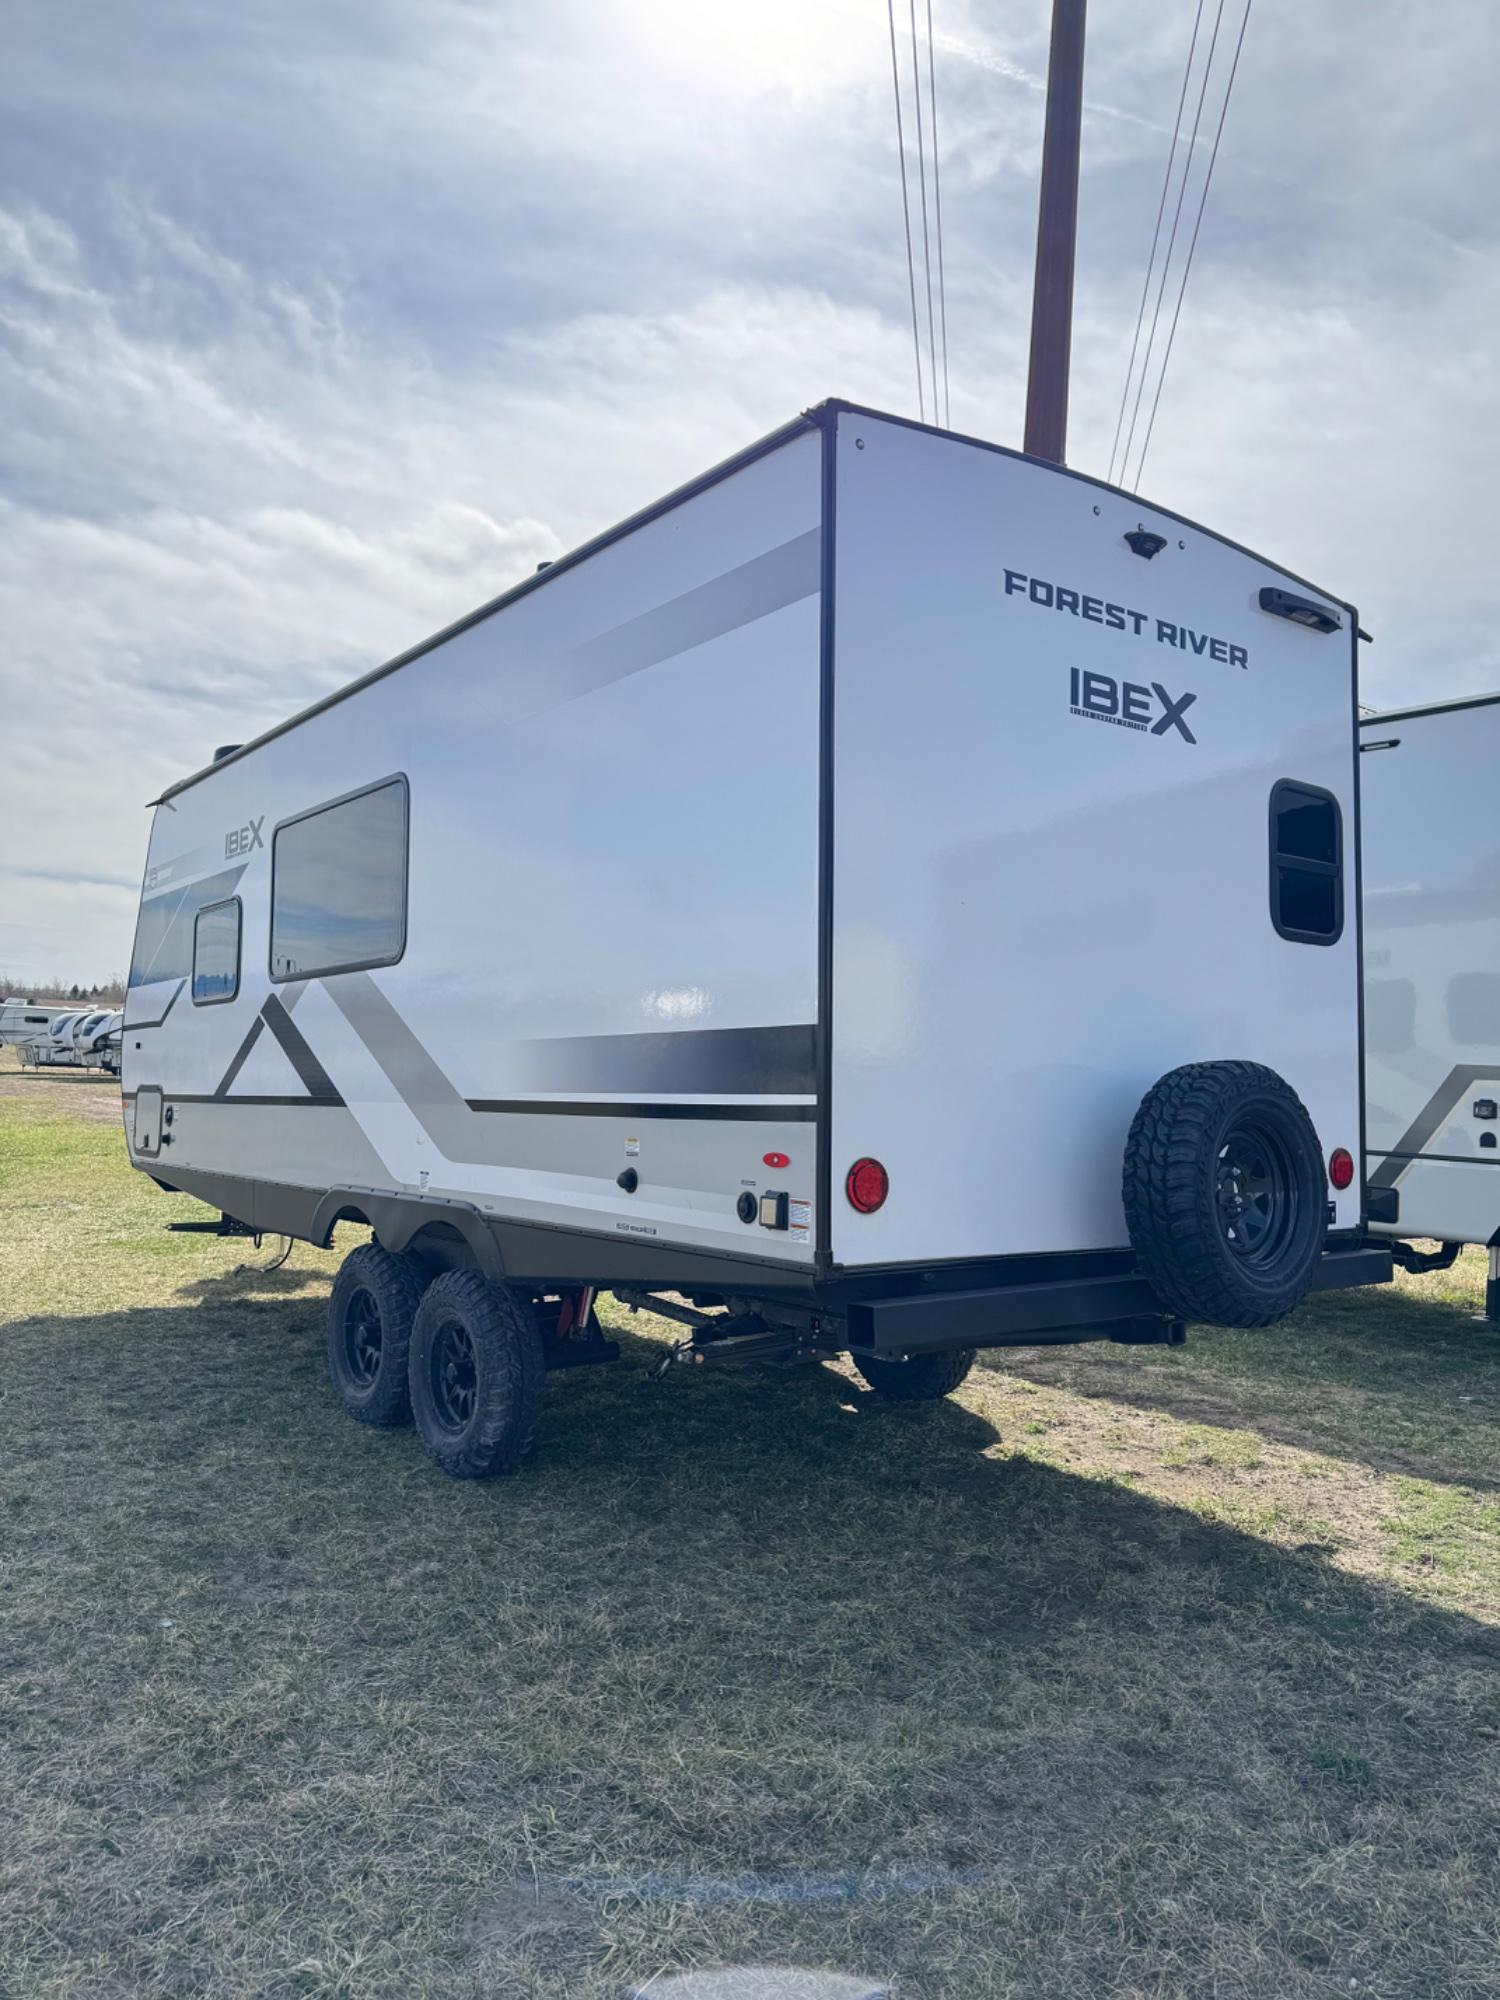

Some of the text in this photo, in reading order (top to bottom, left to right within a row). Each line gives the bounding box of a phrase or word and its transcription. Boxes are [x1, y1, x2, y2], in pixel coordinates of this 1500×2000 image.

[1002, 568, 1249, 670] FOREST RIVER
[1070, 666, 1198, 745] IBEX
[224, 815, 265, 856] IBEX
